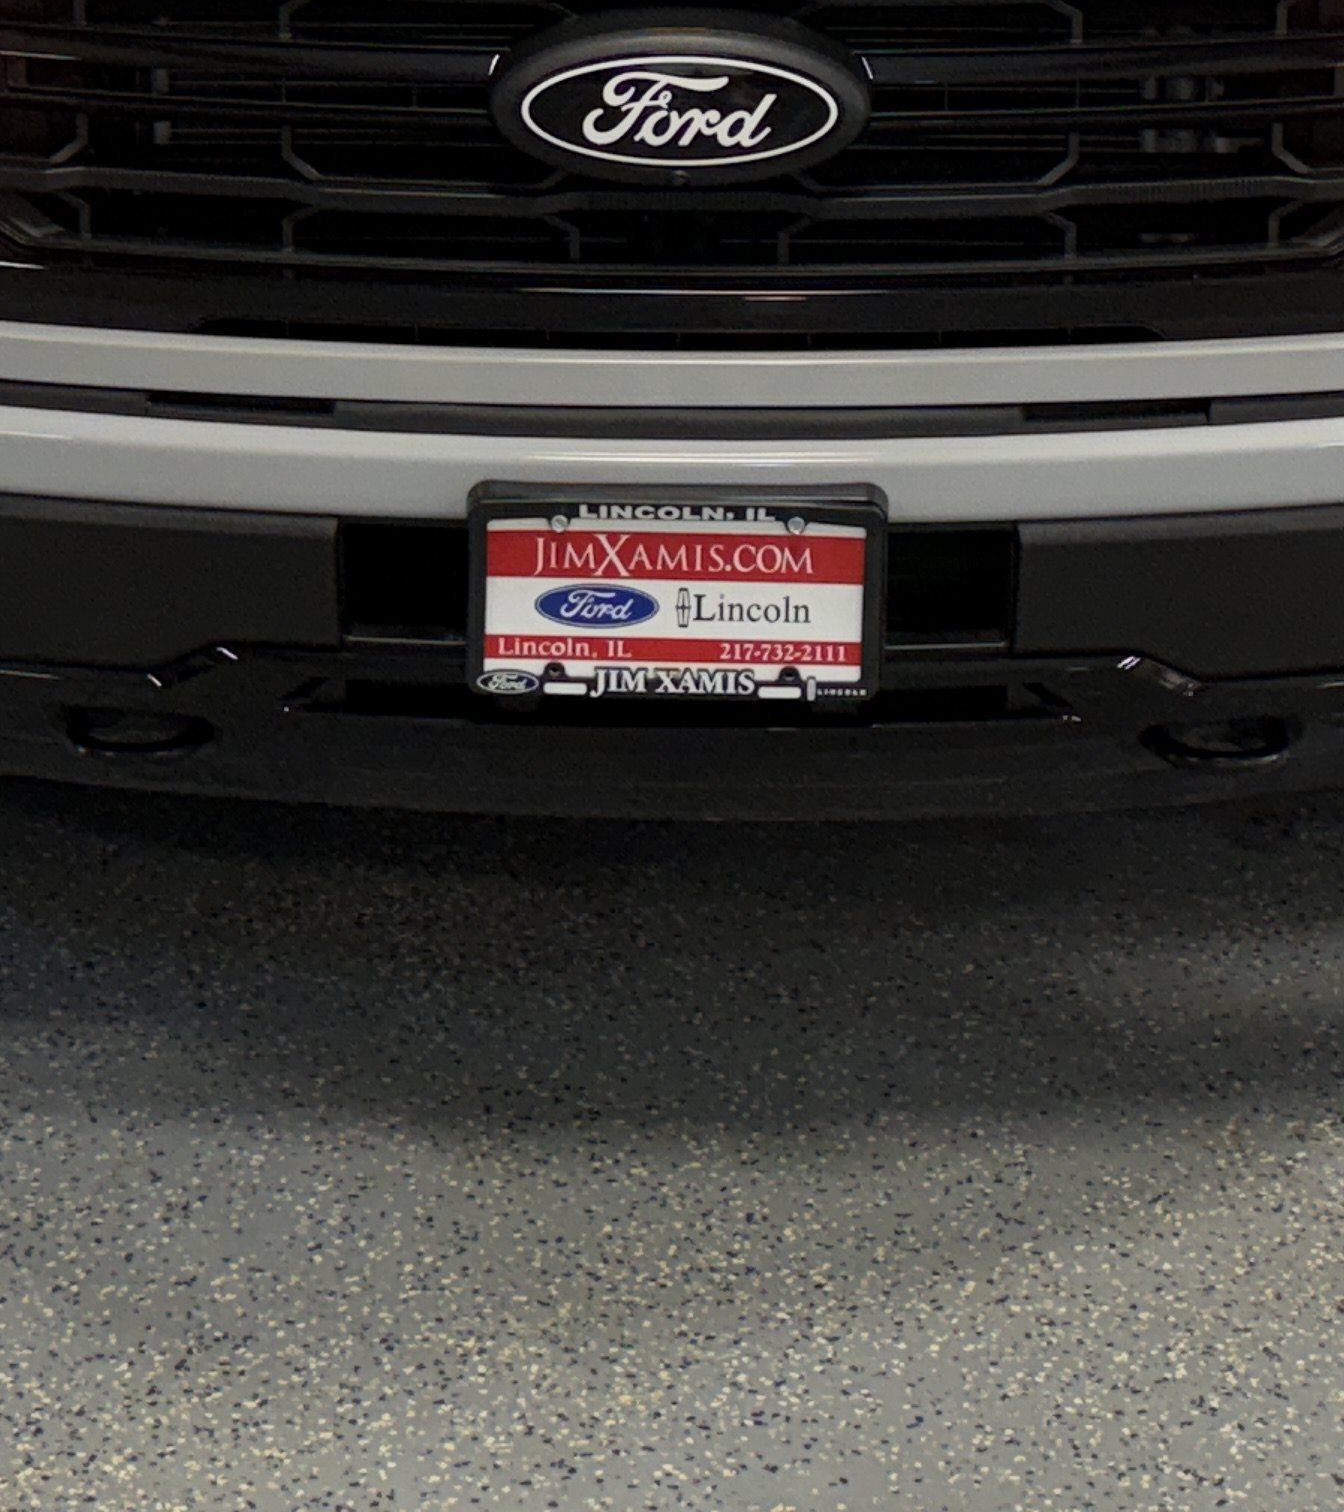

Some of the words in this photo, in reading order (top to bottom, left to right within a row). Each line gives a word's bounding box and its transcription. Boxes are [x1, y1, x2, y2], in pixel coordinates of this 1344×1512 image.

[581, 70, 778, 148] Ford
[745, 506, 776, 522] IL
[533, 534, 814, 577] JIMXAMIS.COM
[559, 587, 635, 621] Ford
[693, 593, 812, 624] Lincoln
[607, 640, 633, 659] IL
[719, 642, 847, 663] 217-732-2111
[488, 672, 528, 690] Ford
[589, 667, 647, 698] JIM
[655, 668, 756, 696] XAMIS
